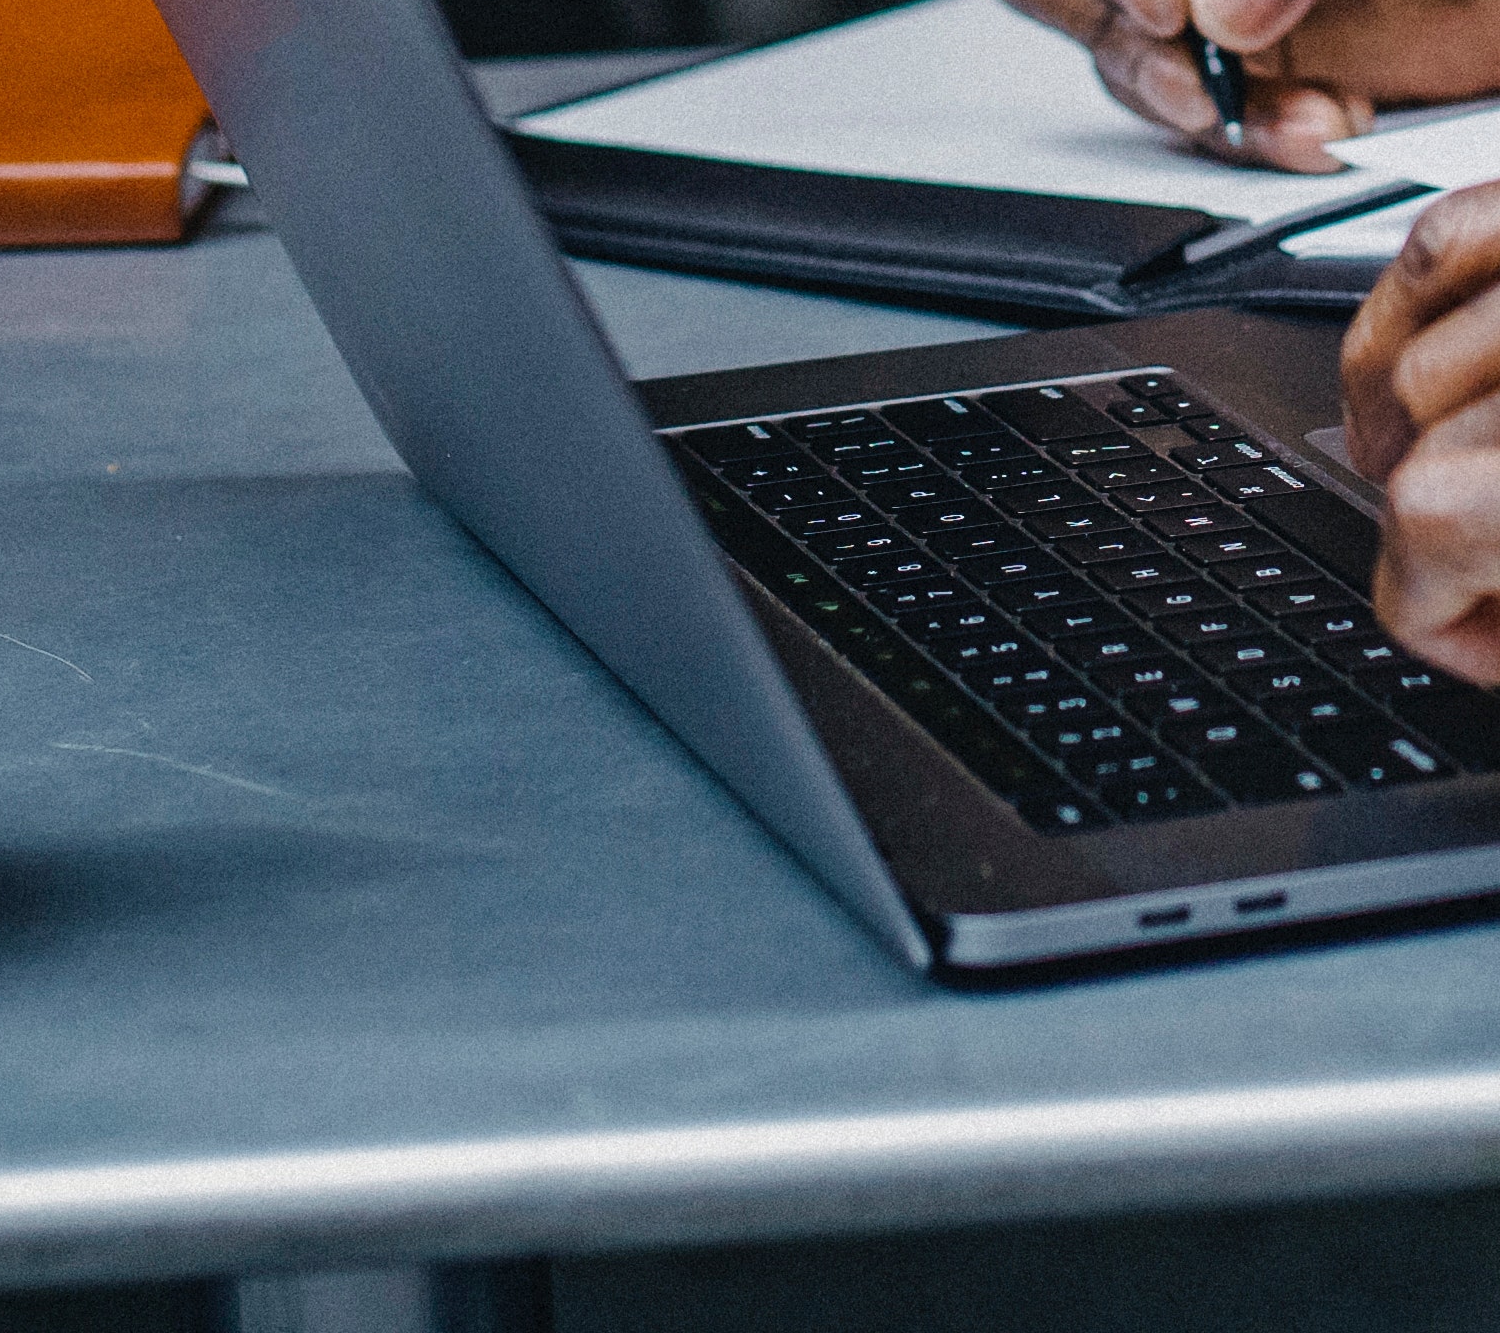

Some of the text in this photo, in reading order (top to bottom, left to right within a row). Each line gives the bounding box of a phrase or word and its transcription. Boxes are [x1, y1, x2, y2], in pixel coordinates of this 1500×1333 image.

[909, 490, 936, 499] P
[1037, 493, 1061, 503] L
[836, 512, 863, 522] 0
[939, 513, 966, 523] O
[1065, 518, 1093, 528] K
[1184, 516, 1214, 528] M
[866, 537, 893, 547] 9
[971, 539, 995, 547] I
[1098, 542, 1125, 551] J
[1218, 541, 1247, 553] N
[896, 562, 923, 573] 8
[1000, 563, 1028, 574] U
[1130, 567, 1160, 579] H
[1254, 566, 1283, 578] B
[926, 590, 954, 599] 7
[1033, 590, 1060, 601] Y
[1165, 594, 1193, 605] G
[1288, 593, 1316, 605] V
[959, 614, 986, 626] 6
[1065, 616, 1093, 628] T
[1325, 619, 1354, 632] C
[1199, 621, 1229, 633] F
[990, 641, 1019, 654] 5
[1100, 642, 1129, 656] R
[1362, 646, 1393, 660] X
[1236, 647, 1266, 662] D
[1134, 669, 1164, 683] E
[1271, 674, 1302, 689] S
[1400, 673, 1432, 689] Z
[1057, 697, 1088, 711] 3
